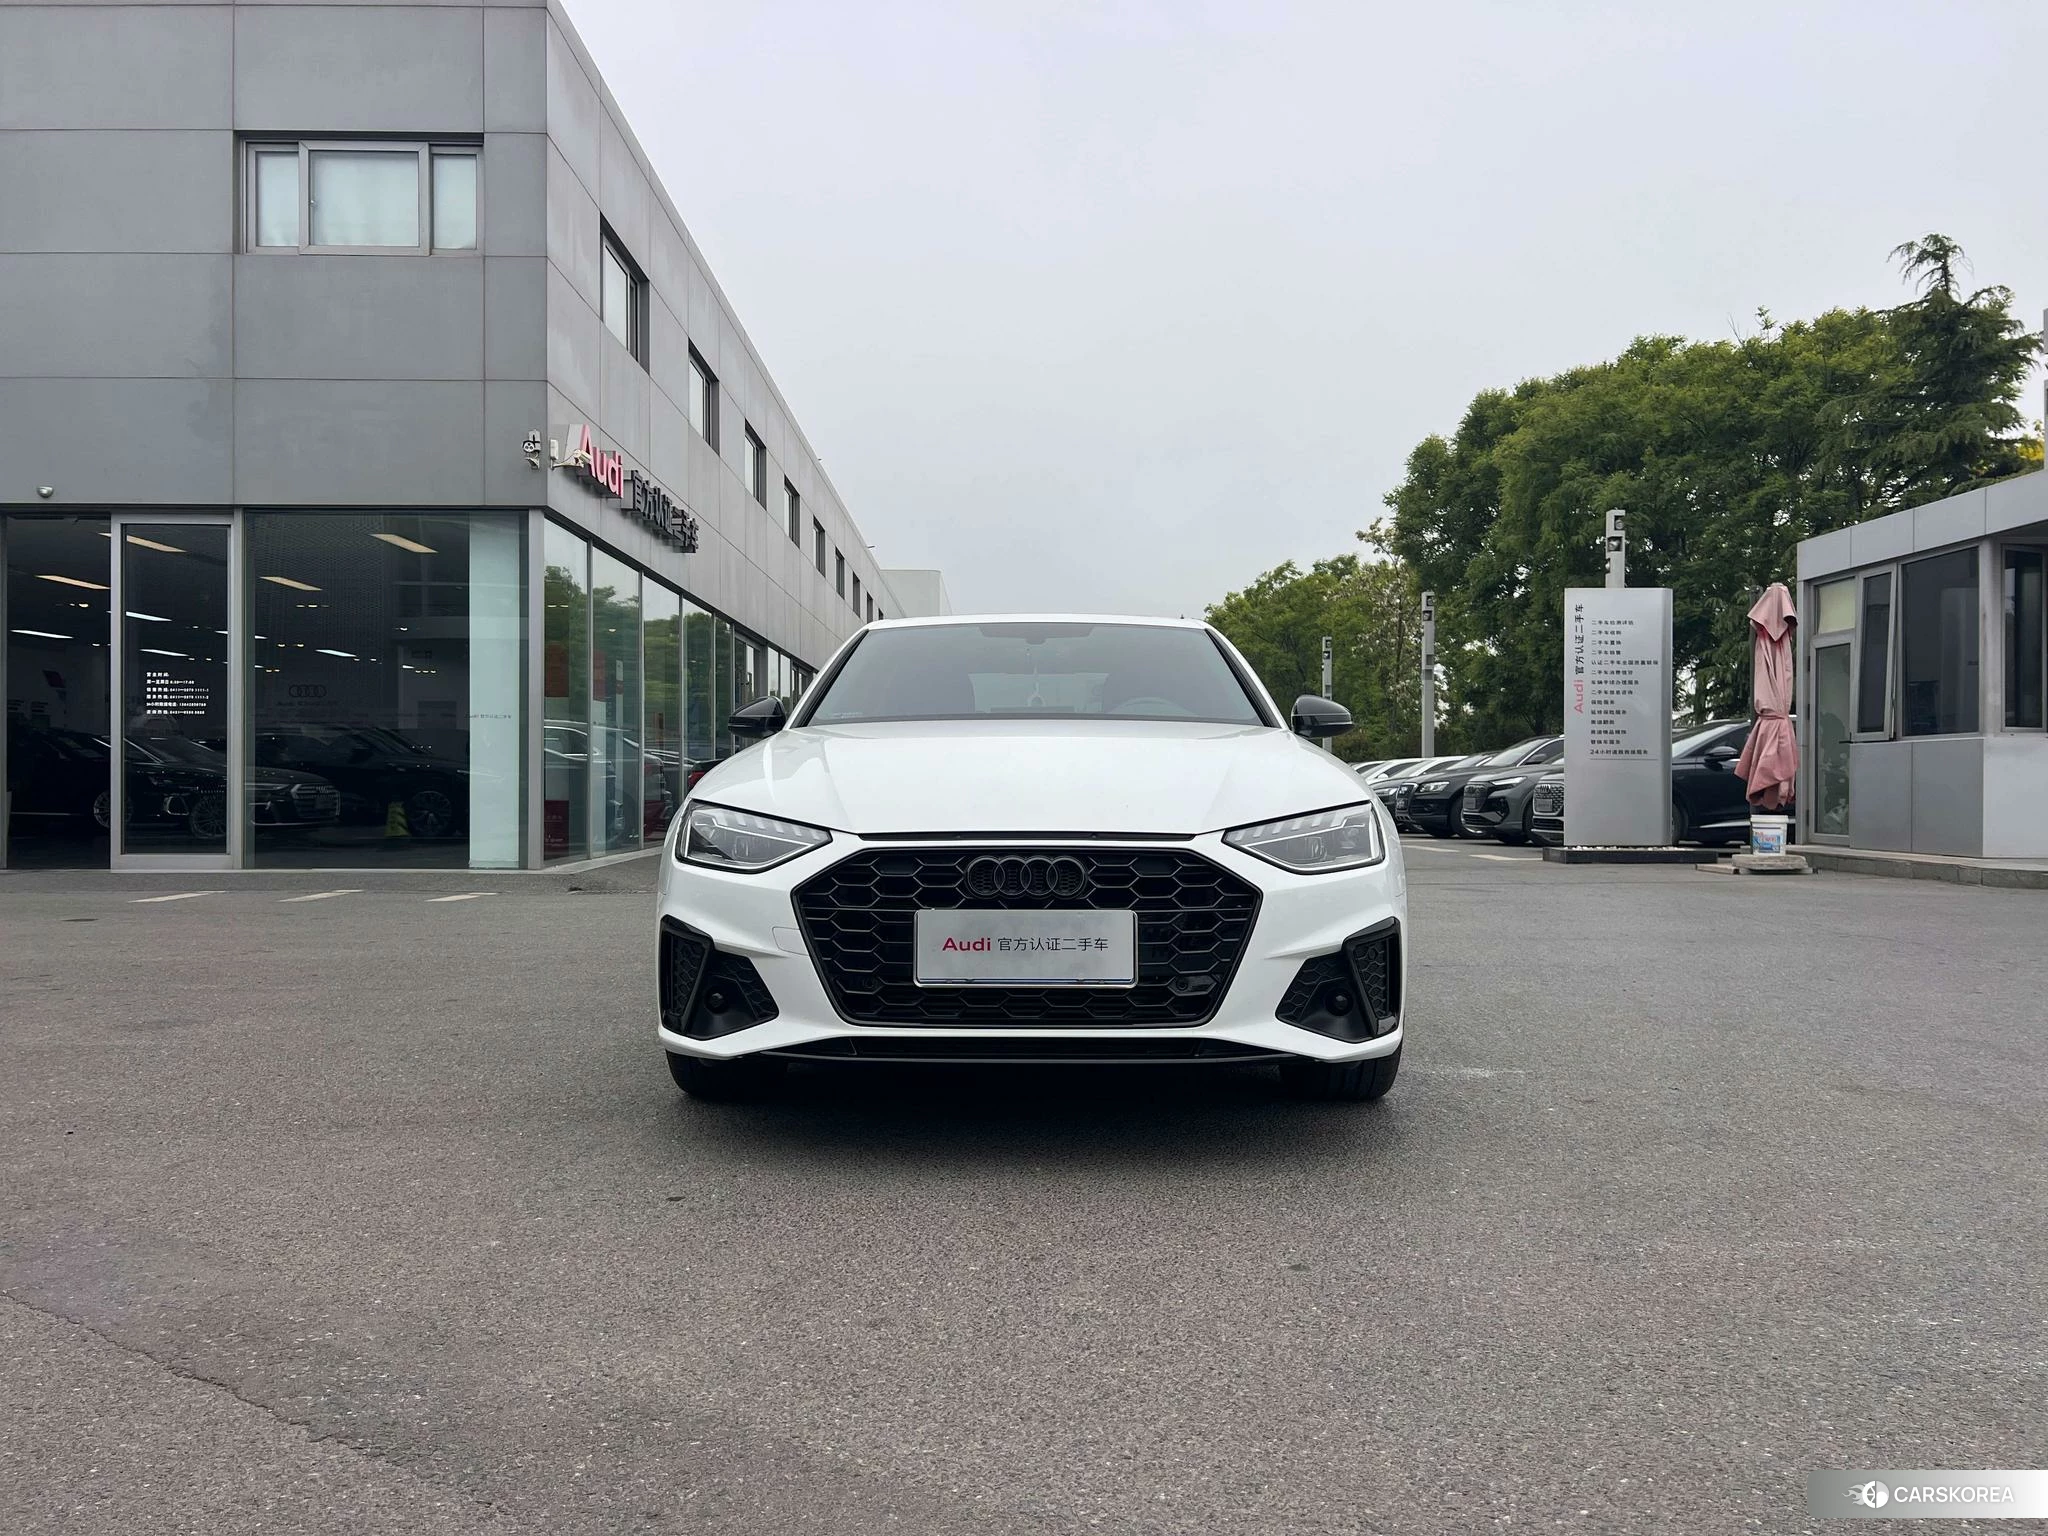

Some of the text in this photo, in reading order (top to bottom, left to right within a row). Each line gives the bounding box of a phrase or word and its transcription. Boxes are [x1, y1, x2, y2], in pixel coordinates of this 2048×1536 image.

[579, 423, 624, 499] Audi
[1574, 603, 1584, 714] Audi 官方认证二手车
[942, 937, 1109, 952] Audi 官方认证二手车
